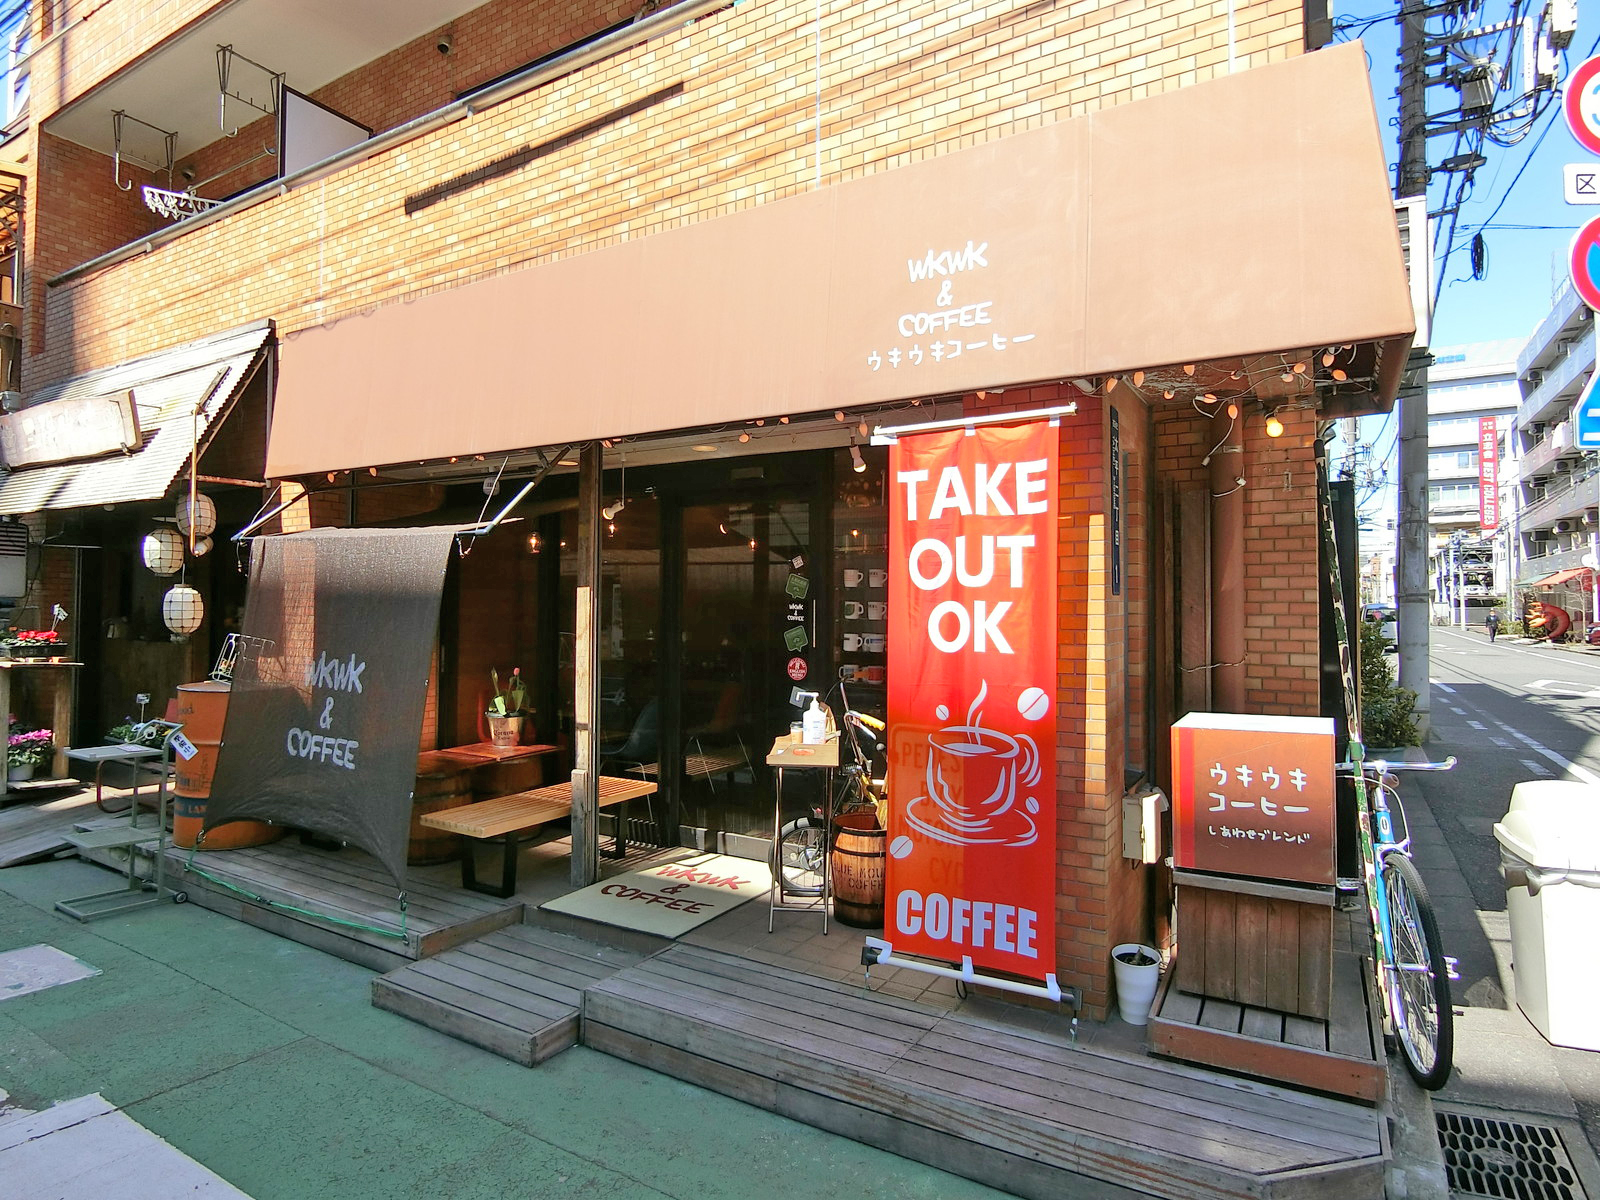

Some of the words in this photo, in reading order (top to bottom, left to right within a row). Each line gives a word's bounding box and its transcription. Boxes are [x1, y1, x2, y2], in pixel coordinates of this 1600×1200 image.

[936, 279, 953, 307] &
[897, 301, 993, 338] COFFEE
[867, 333, 1036, 372] ウキウキコーヒー
[896, 458, 1048, 521] TAKE
[908, 534, 1035, 591] OUT
[927, 599, 1015, 655] OK
[320, 696, 335, 730] &
[287, 727, 360, 770] COFFEE
[1209, 762, 1308, 792] ウキウキ
[1208, 792, 1310, 816] コーヒー
[1208, 825, 1311, 845] しあわせブレンド
[600, 884, 715, 914] COFFEE
[659, 883, 691, 895] &
[896, 889, 1038, 959] COFFEE
